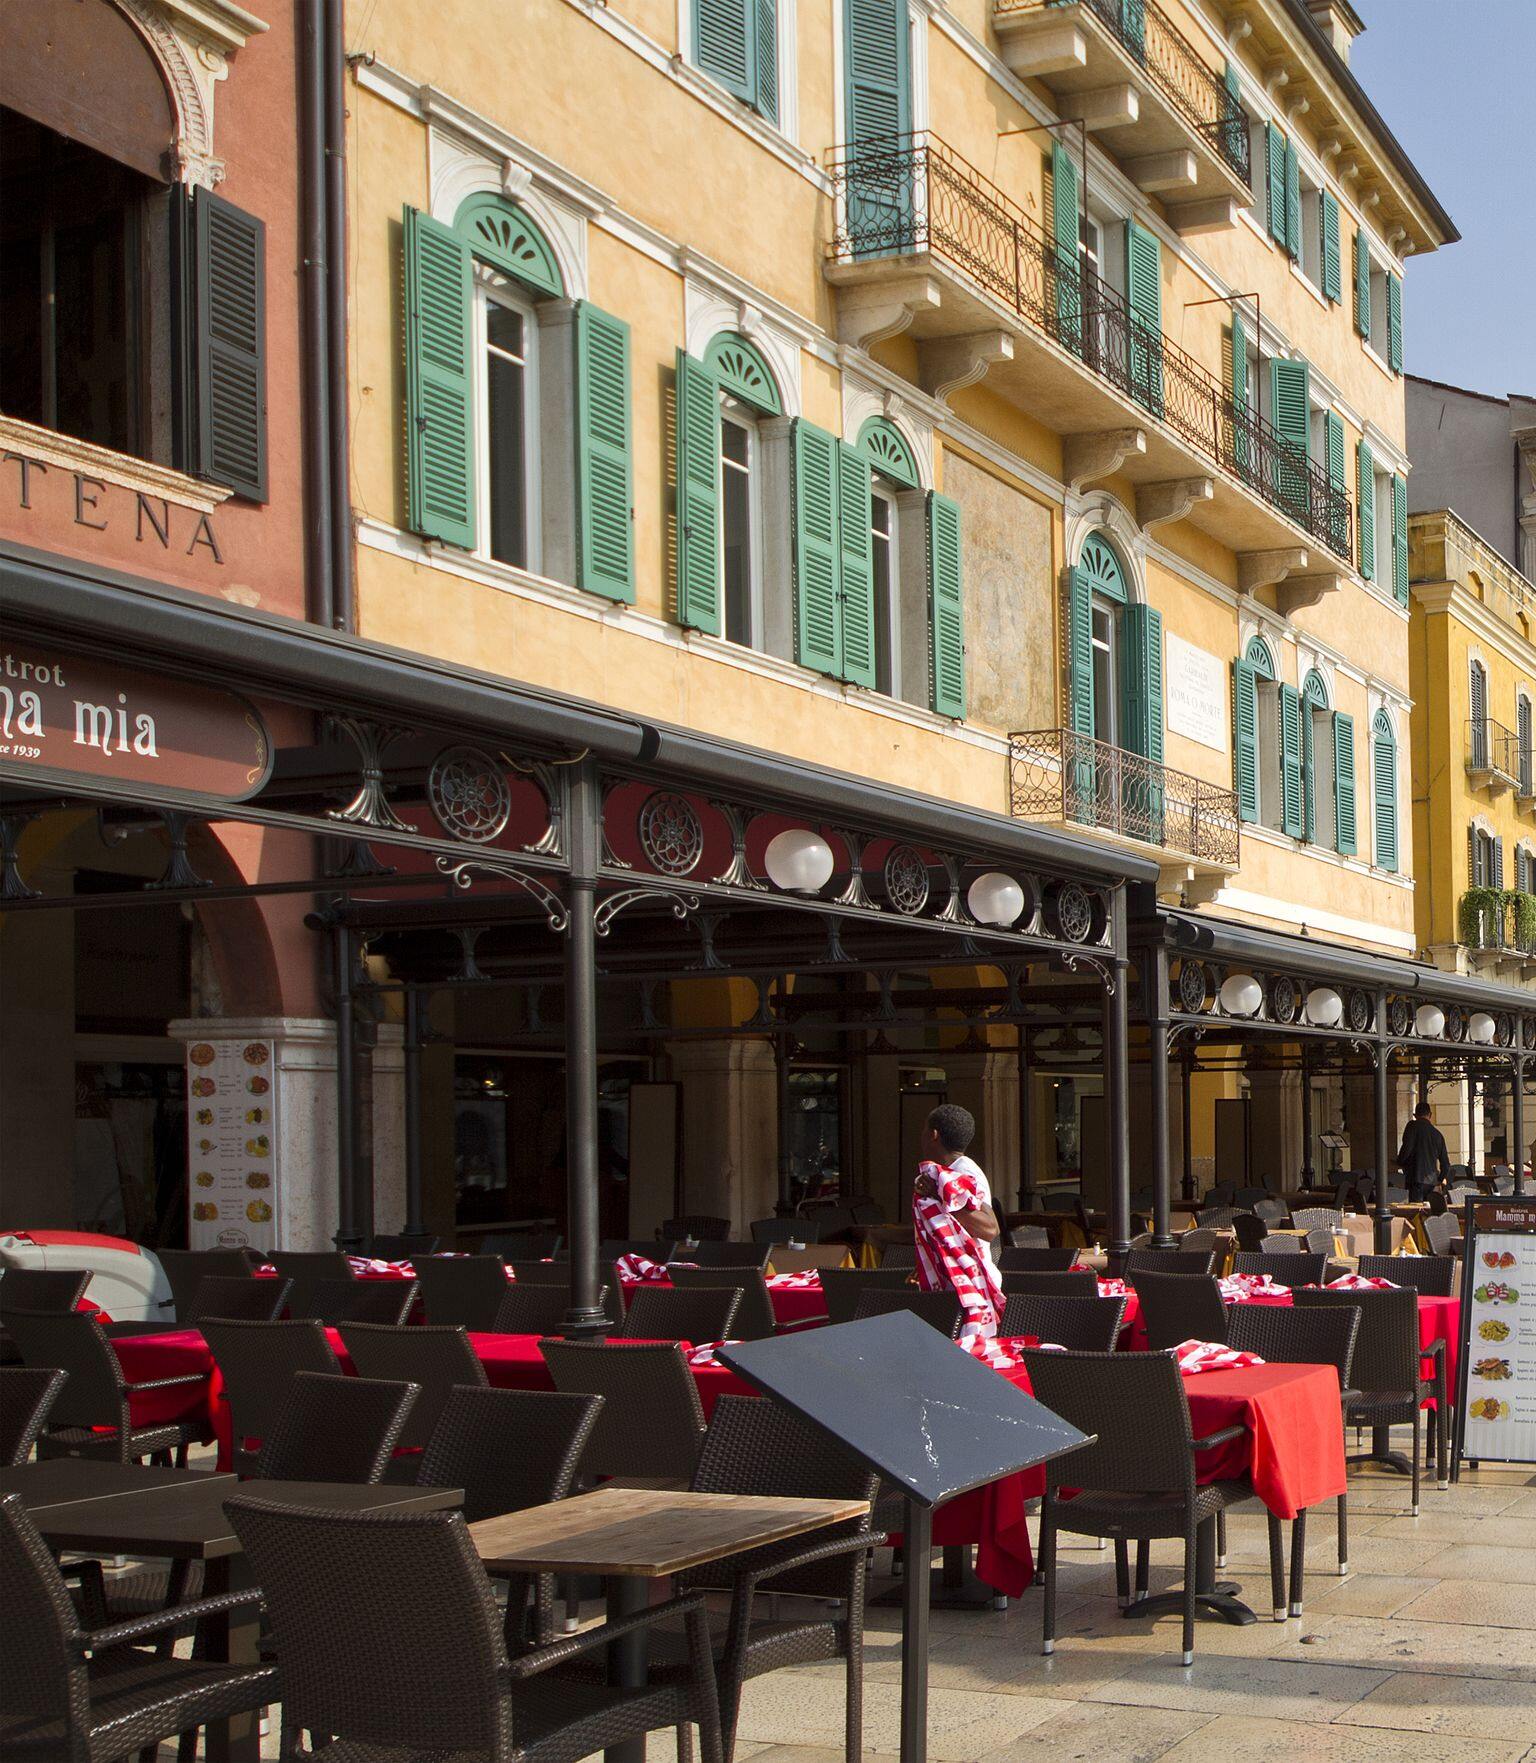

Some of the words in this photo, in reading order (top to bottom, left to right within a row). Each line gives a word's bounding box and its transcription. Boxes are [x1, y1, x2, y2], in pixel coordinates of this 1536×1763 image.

[3, 452, 225, 564] TENA
[0, 654, 65, 687] trot
[73, 693, 160, 757] mia
[13, 745, 41, 758] 1939
[1495, 1210, 1525, 1223] Mamma
